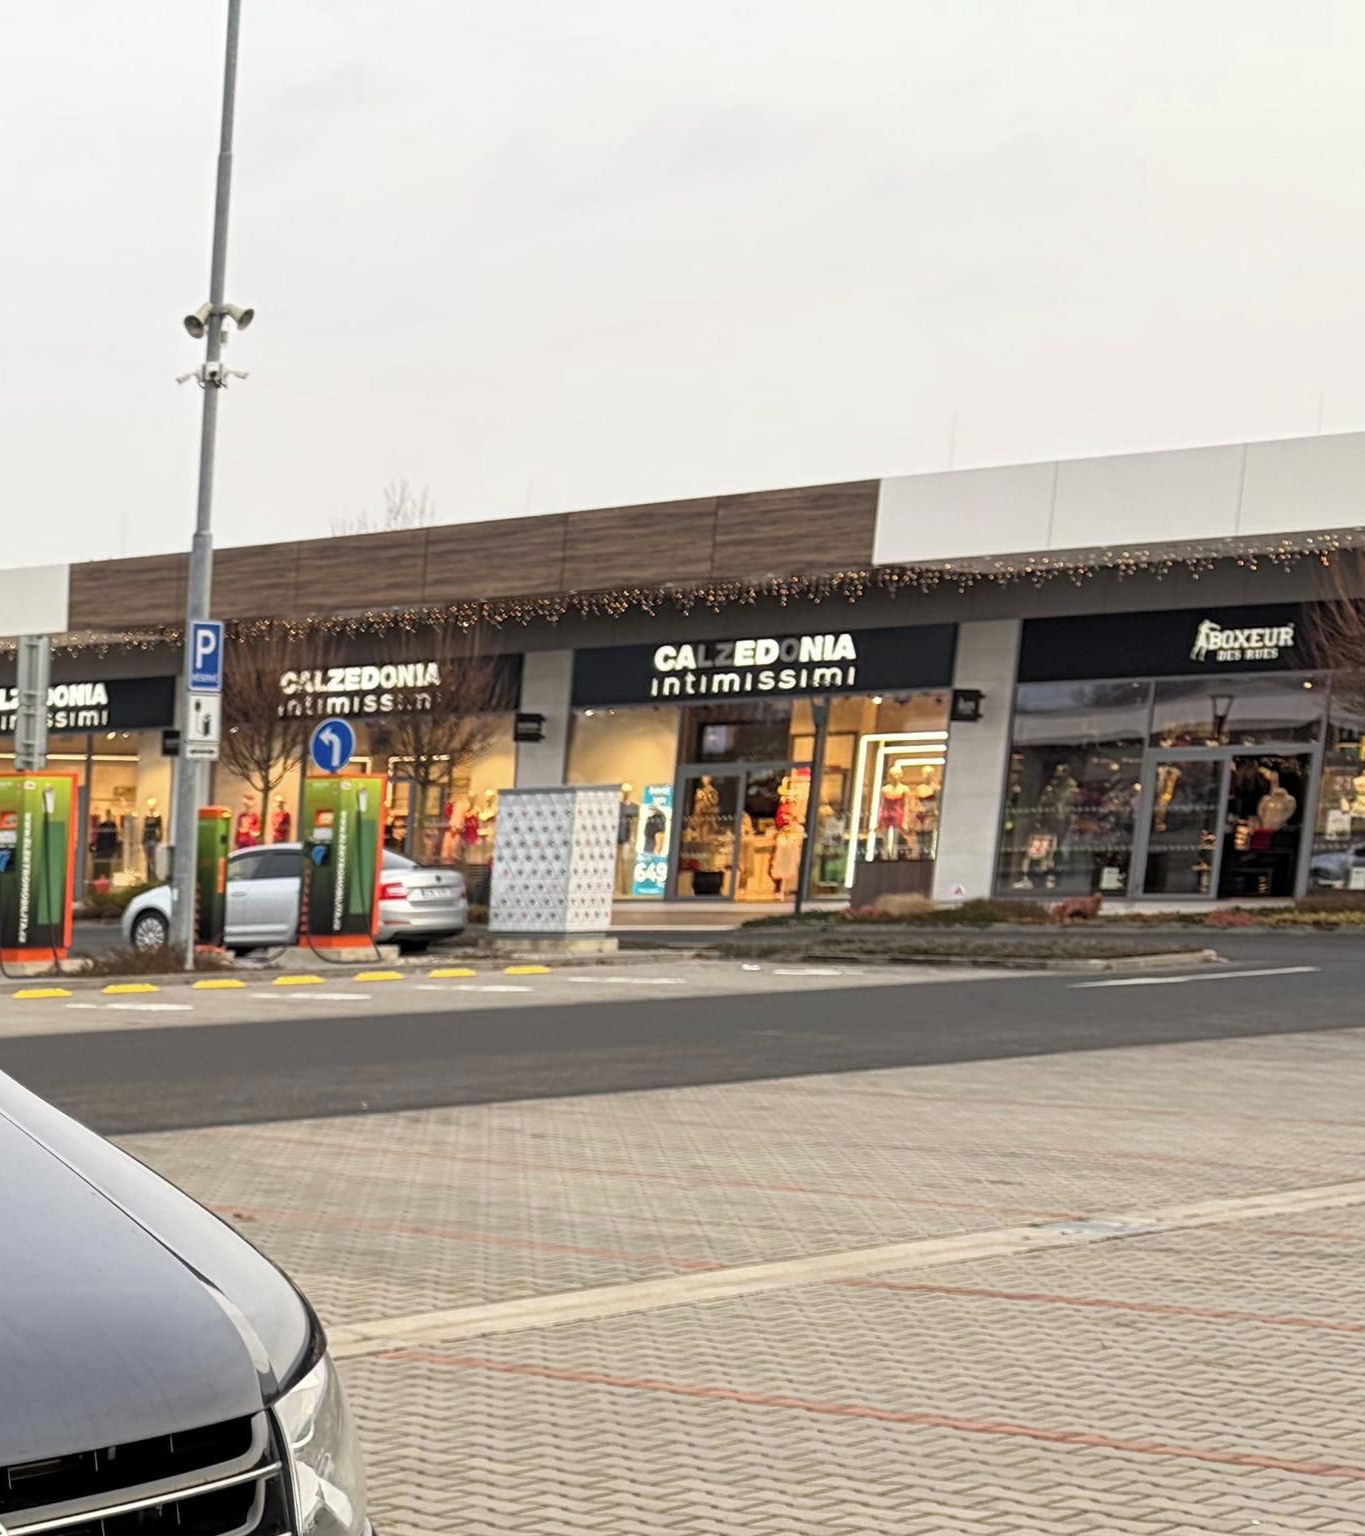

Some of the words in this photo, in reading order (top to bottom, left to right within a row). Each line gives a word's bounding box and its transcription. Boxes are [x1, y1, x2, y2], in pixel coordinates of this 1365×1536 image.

[195, 629, 217, 669] P
[654, 633, 857, 672] CALZEDONIA
[1208, 627, 1295, 650] BOXEUR
[1216, 649, 1242, 661] DES
[1243, 648, 1279, 660] RUES
[279, 662, 442, 695] CALZEDONIA
[650, 666, 856, 697] intimissimi
